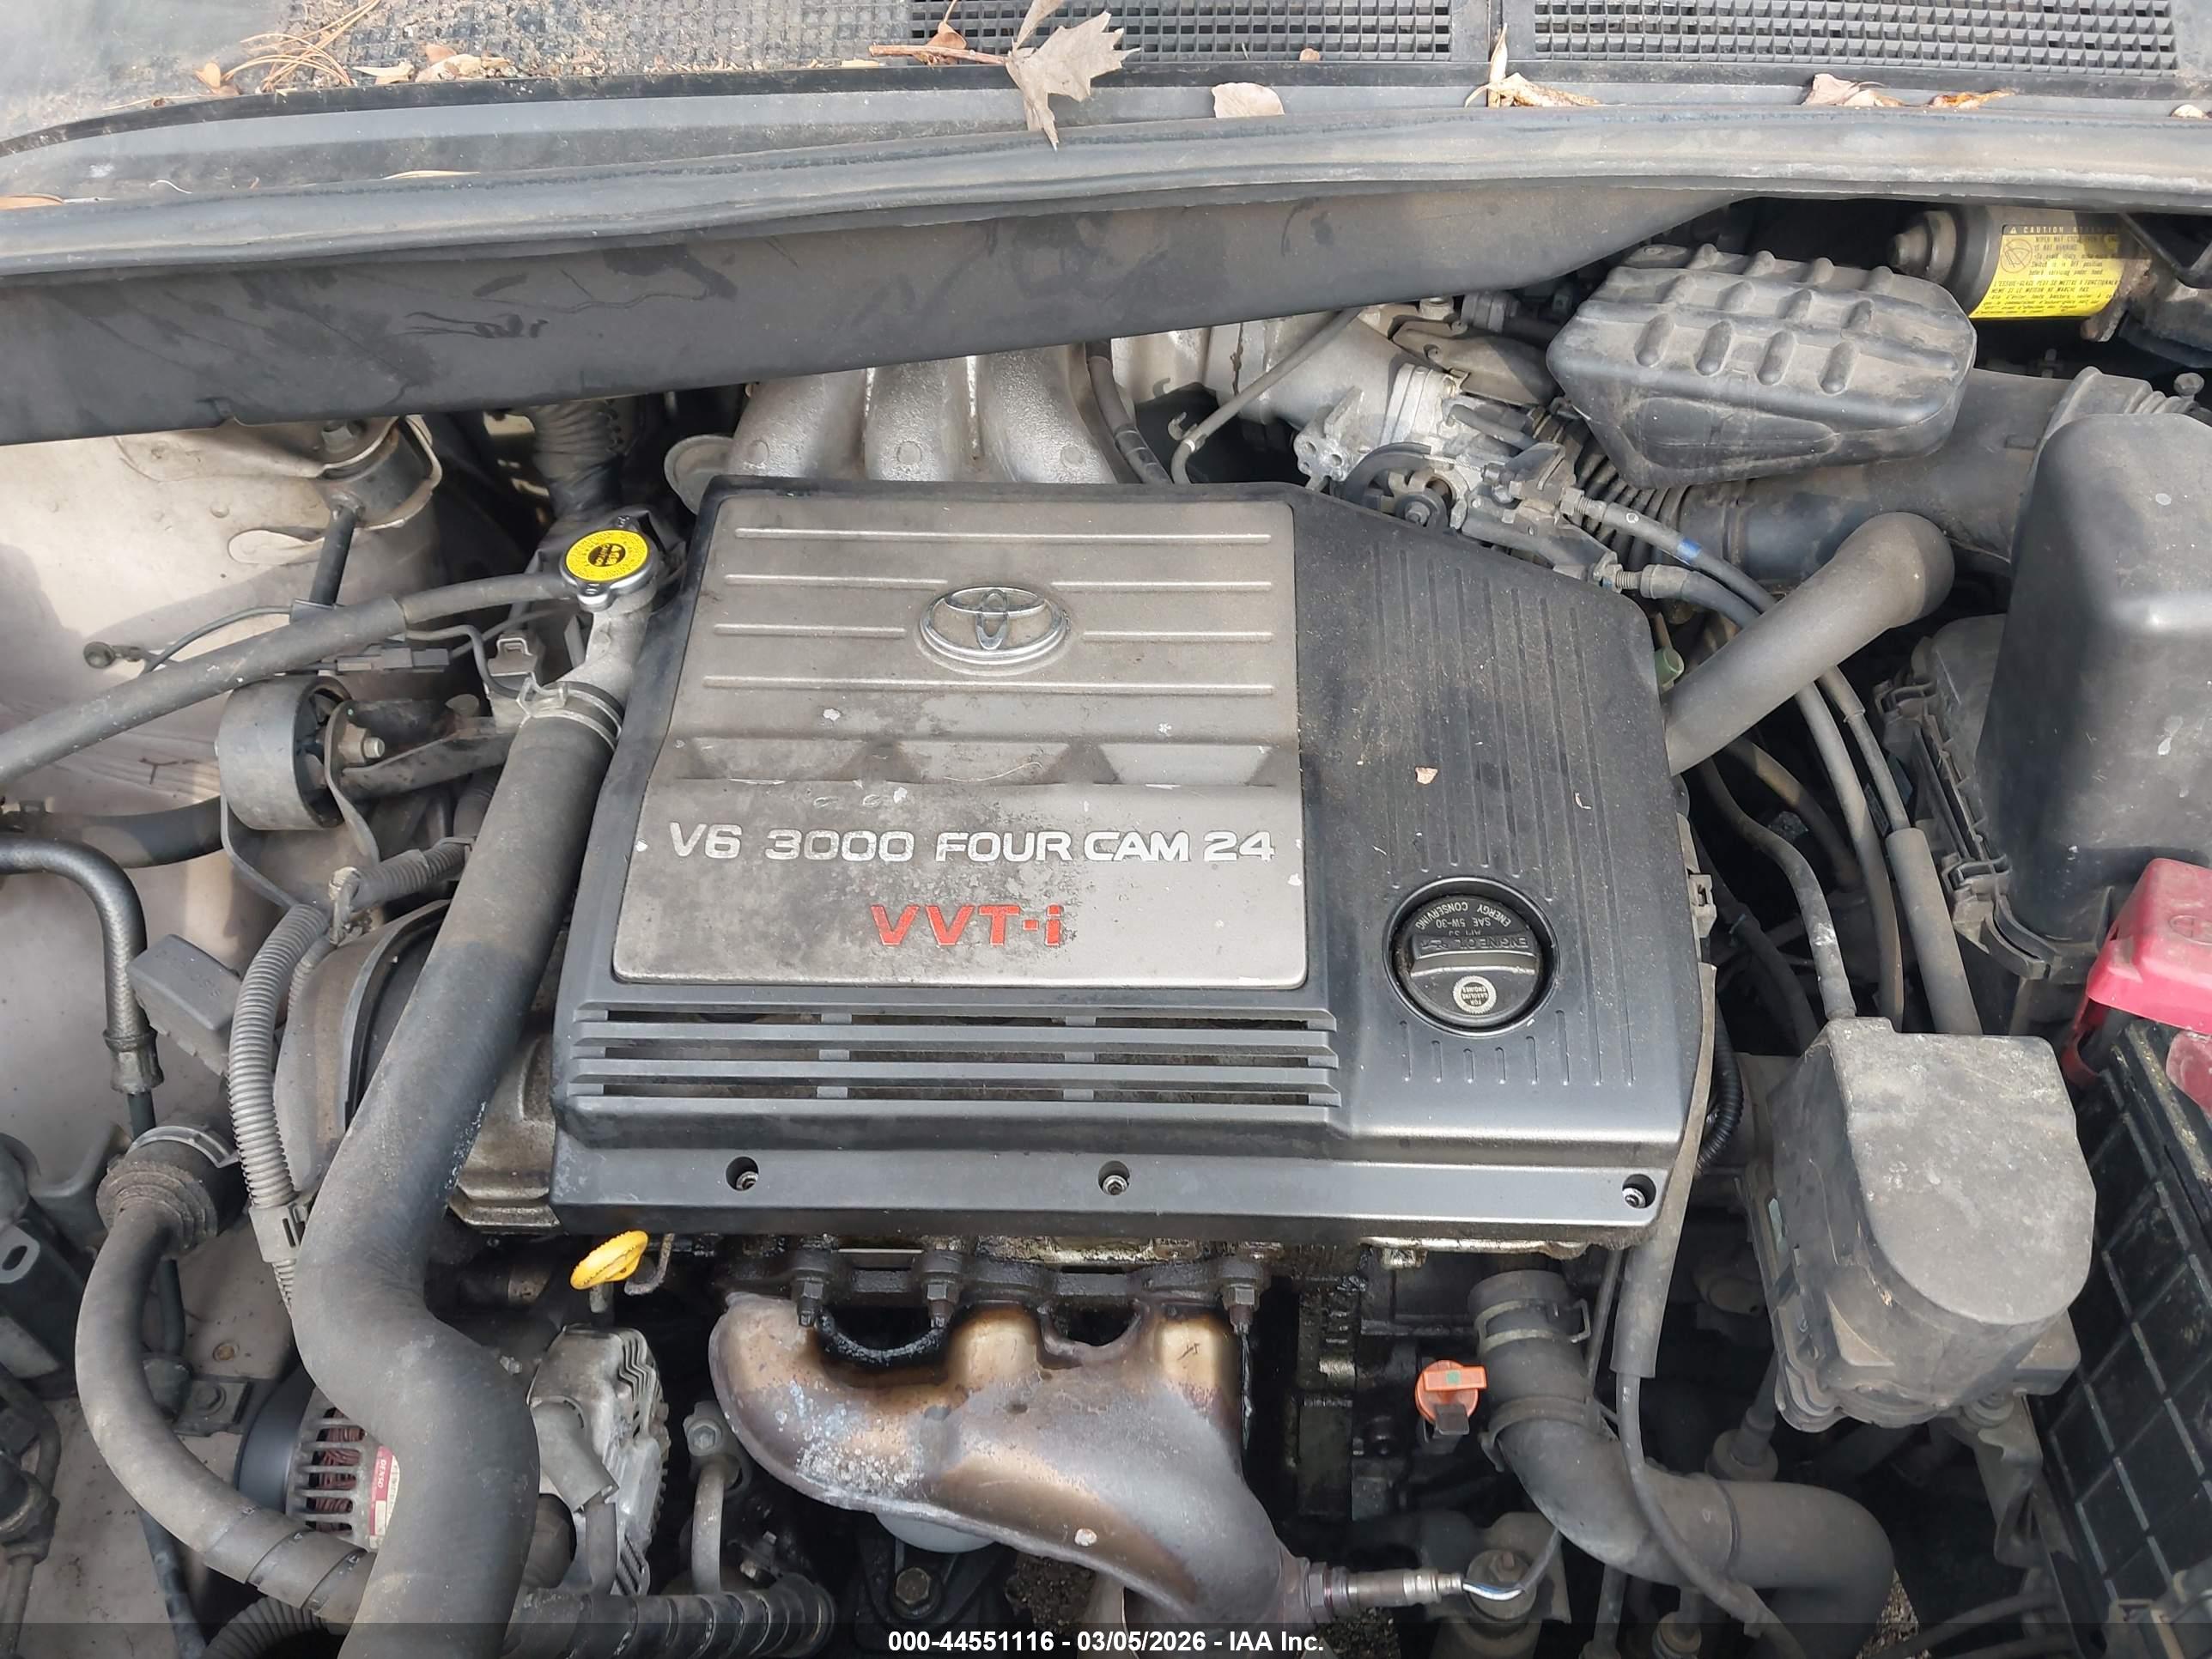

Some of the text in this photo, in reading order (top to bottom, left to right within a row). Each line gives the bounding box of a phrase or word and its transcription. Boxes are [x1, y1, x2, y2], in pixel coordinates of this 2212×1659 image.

[667, 821, 1276, 863] V6 3000 FOUR CAM 24
[872, 904, 1065, 947] VVT-i
[1415, 901, 1512, 930] ENERGY CONSERVING
[1435, 916, 1492, 929] SAE 5W-30
[1455, 937, 1529, 950] ENGINE OIL
[378, 1459, 386, 1489] DENSO
